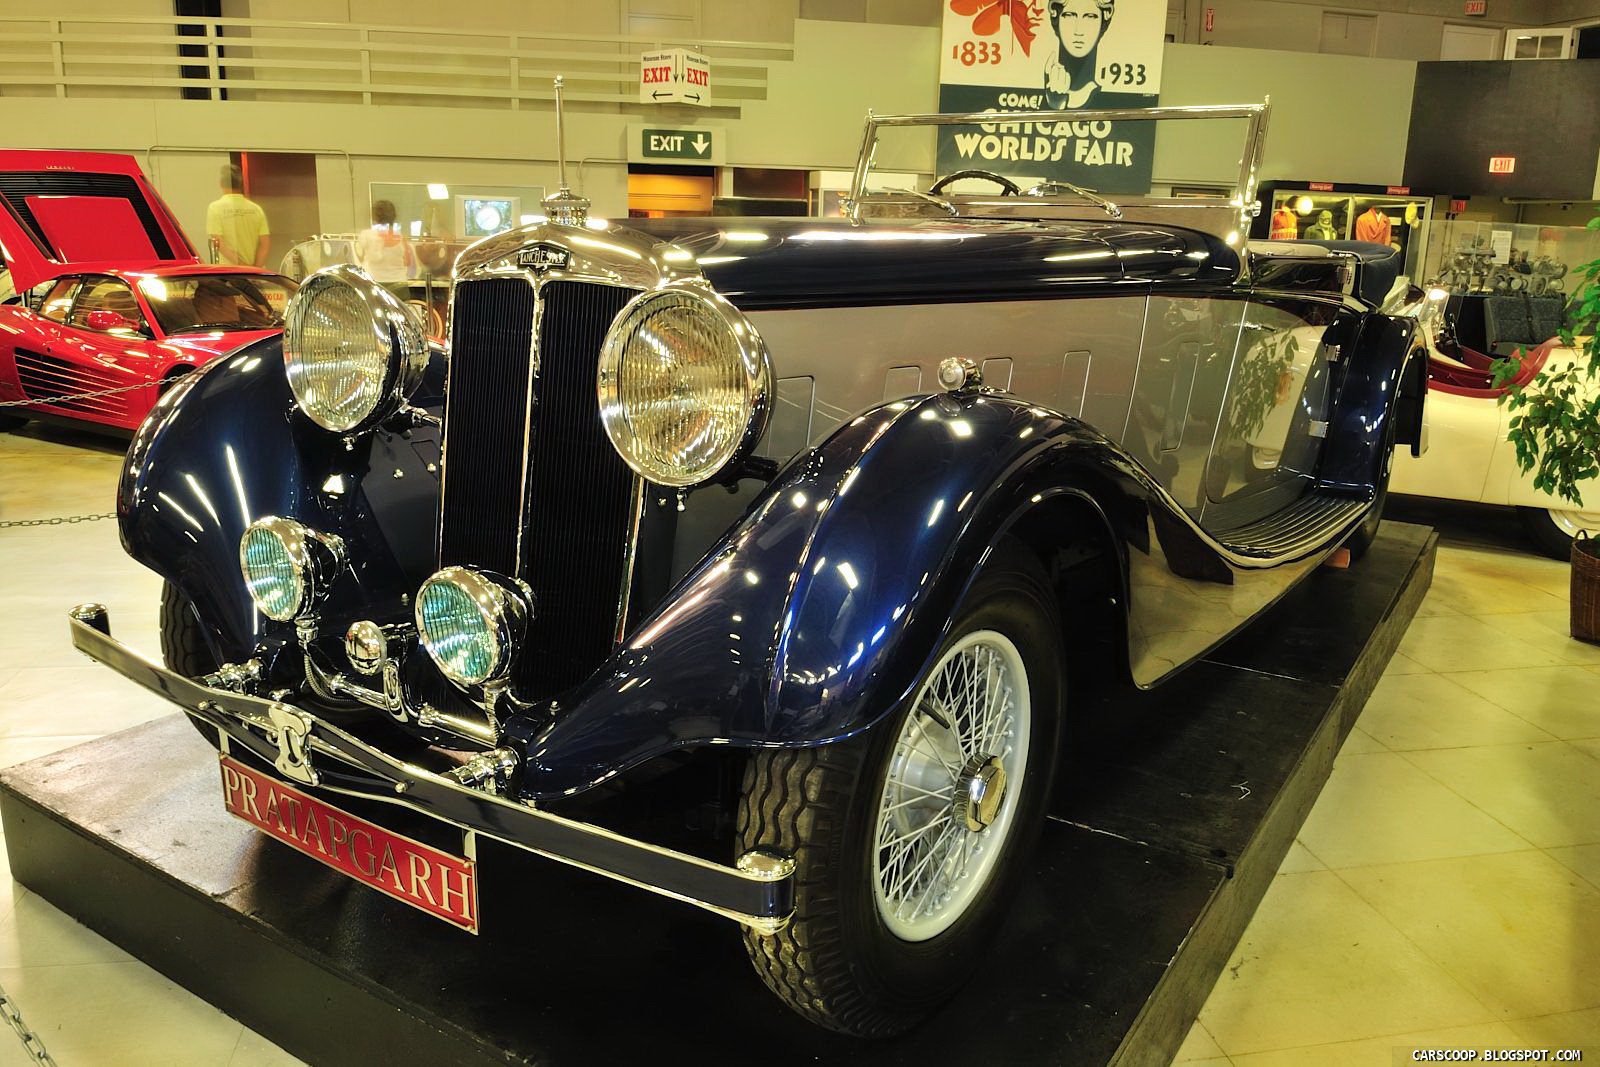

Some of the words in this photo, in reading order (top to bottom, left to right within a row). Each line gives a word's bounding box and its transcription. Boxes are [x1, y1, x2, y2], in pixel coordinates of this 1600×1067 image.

[1466, 2, 1484, 13] EXIT
[952, 40, 1002, 67] 1833
[643, 66, 672, 83] EXIT
[686, 67, 709, 86] EXIT
[1101, 62, 1147, 86] 1933
[998, 92, 1044, 109] COME!
[650, 135, 685, 152] EXIT
[954, 132, 1067, 162] WORLD'S
[1074, 139, 1134, 167] FAIR
[1493, 159, 1512, 172] EXIT
[222, 764, 474, 921] PRATAPGARH
